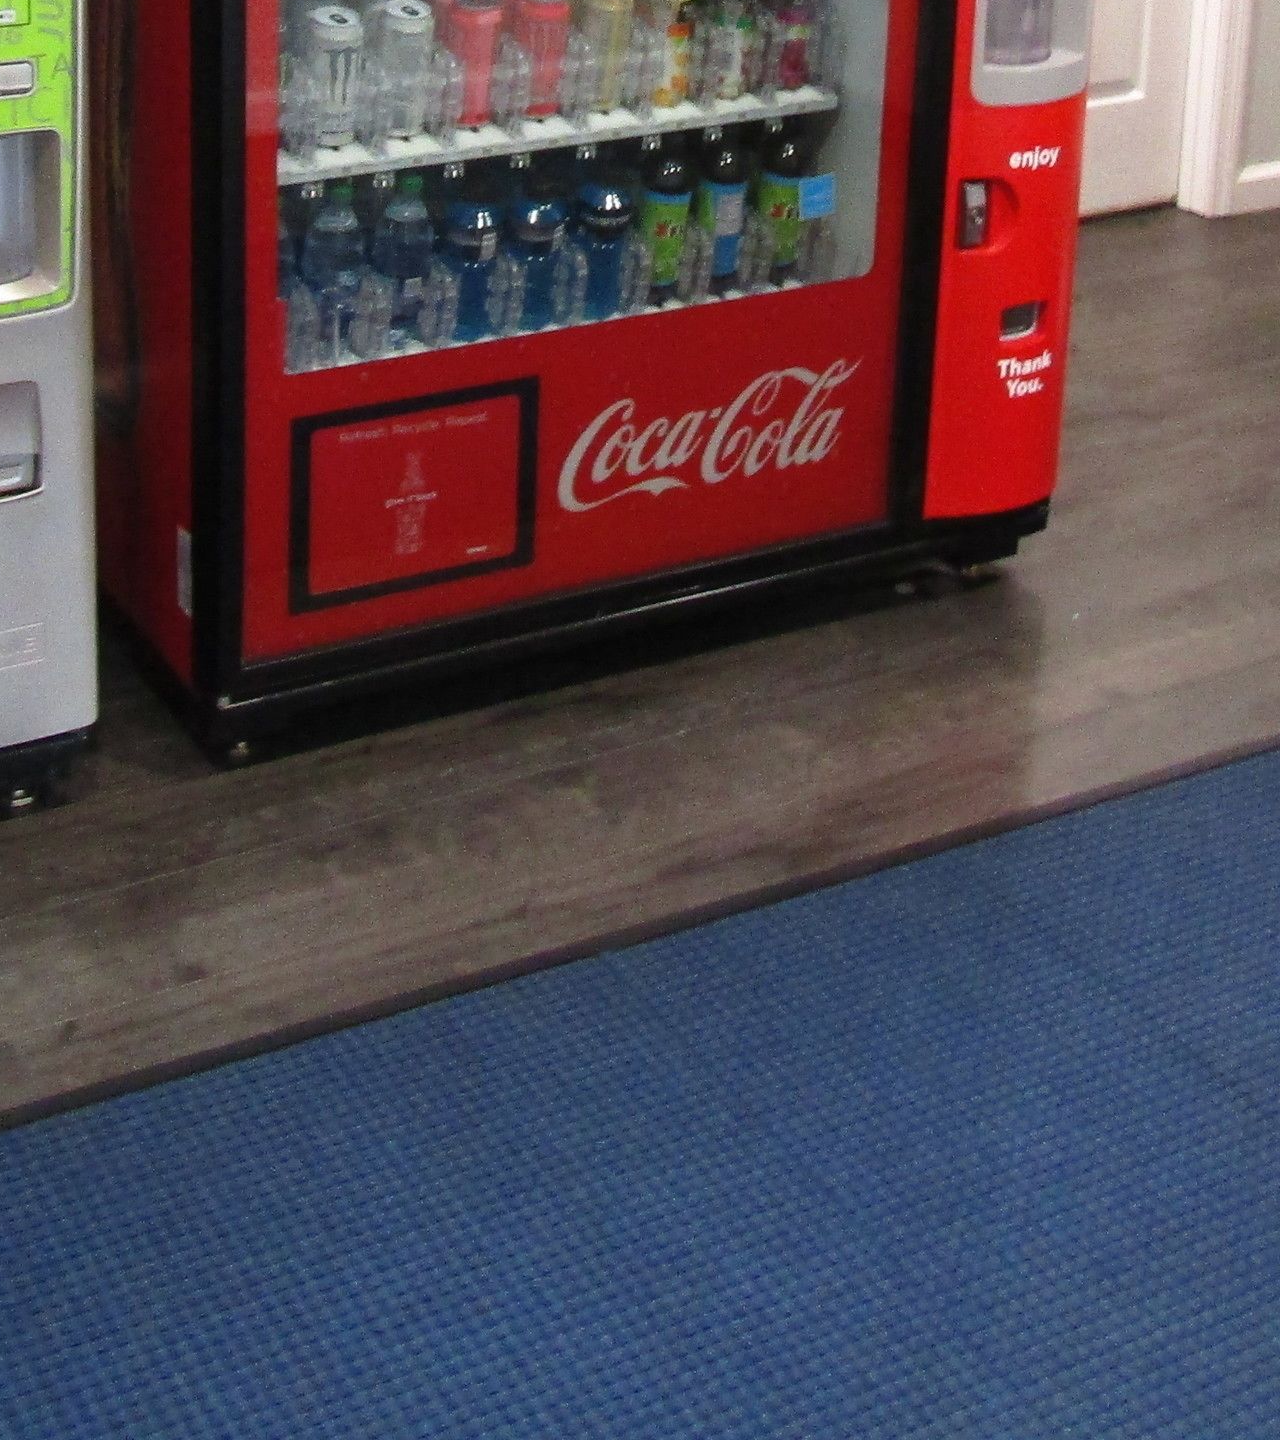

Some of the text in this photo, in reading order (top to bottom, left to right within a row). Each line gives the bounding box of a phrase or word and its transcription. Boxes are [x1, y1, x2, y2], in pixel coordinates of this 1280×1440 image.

[1008, 144, 1062, 170] enjoy
[997, 349, 1052, 378] Thank
[1006, 377, 1045, 399] You.
[557, 357, 863, 512] Coca-Cola
